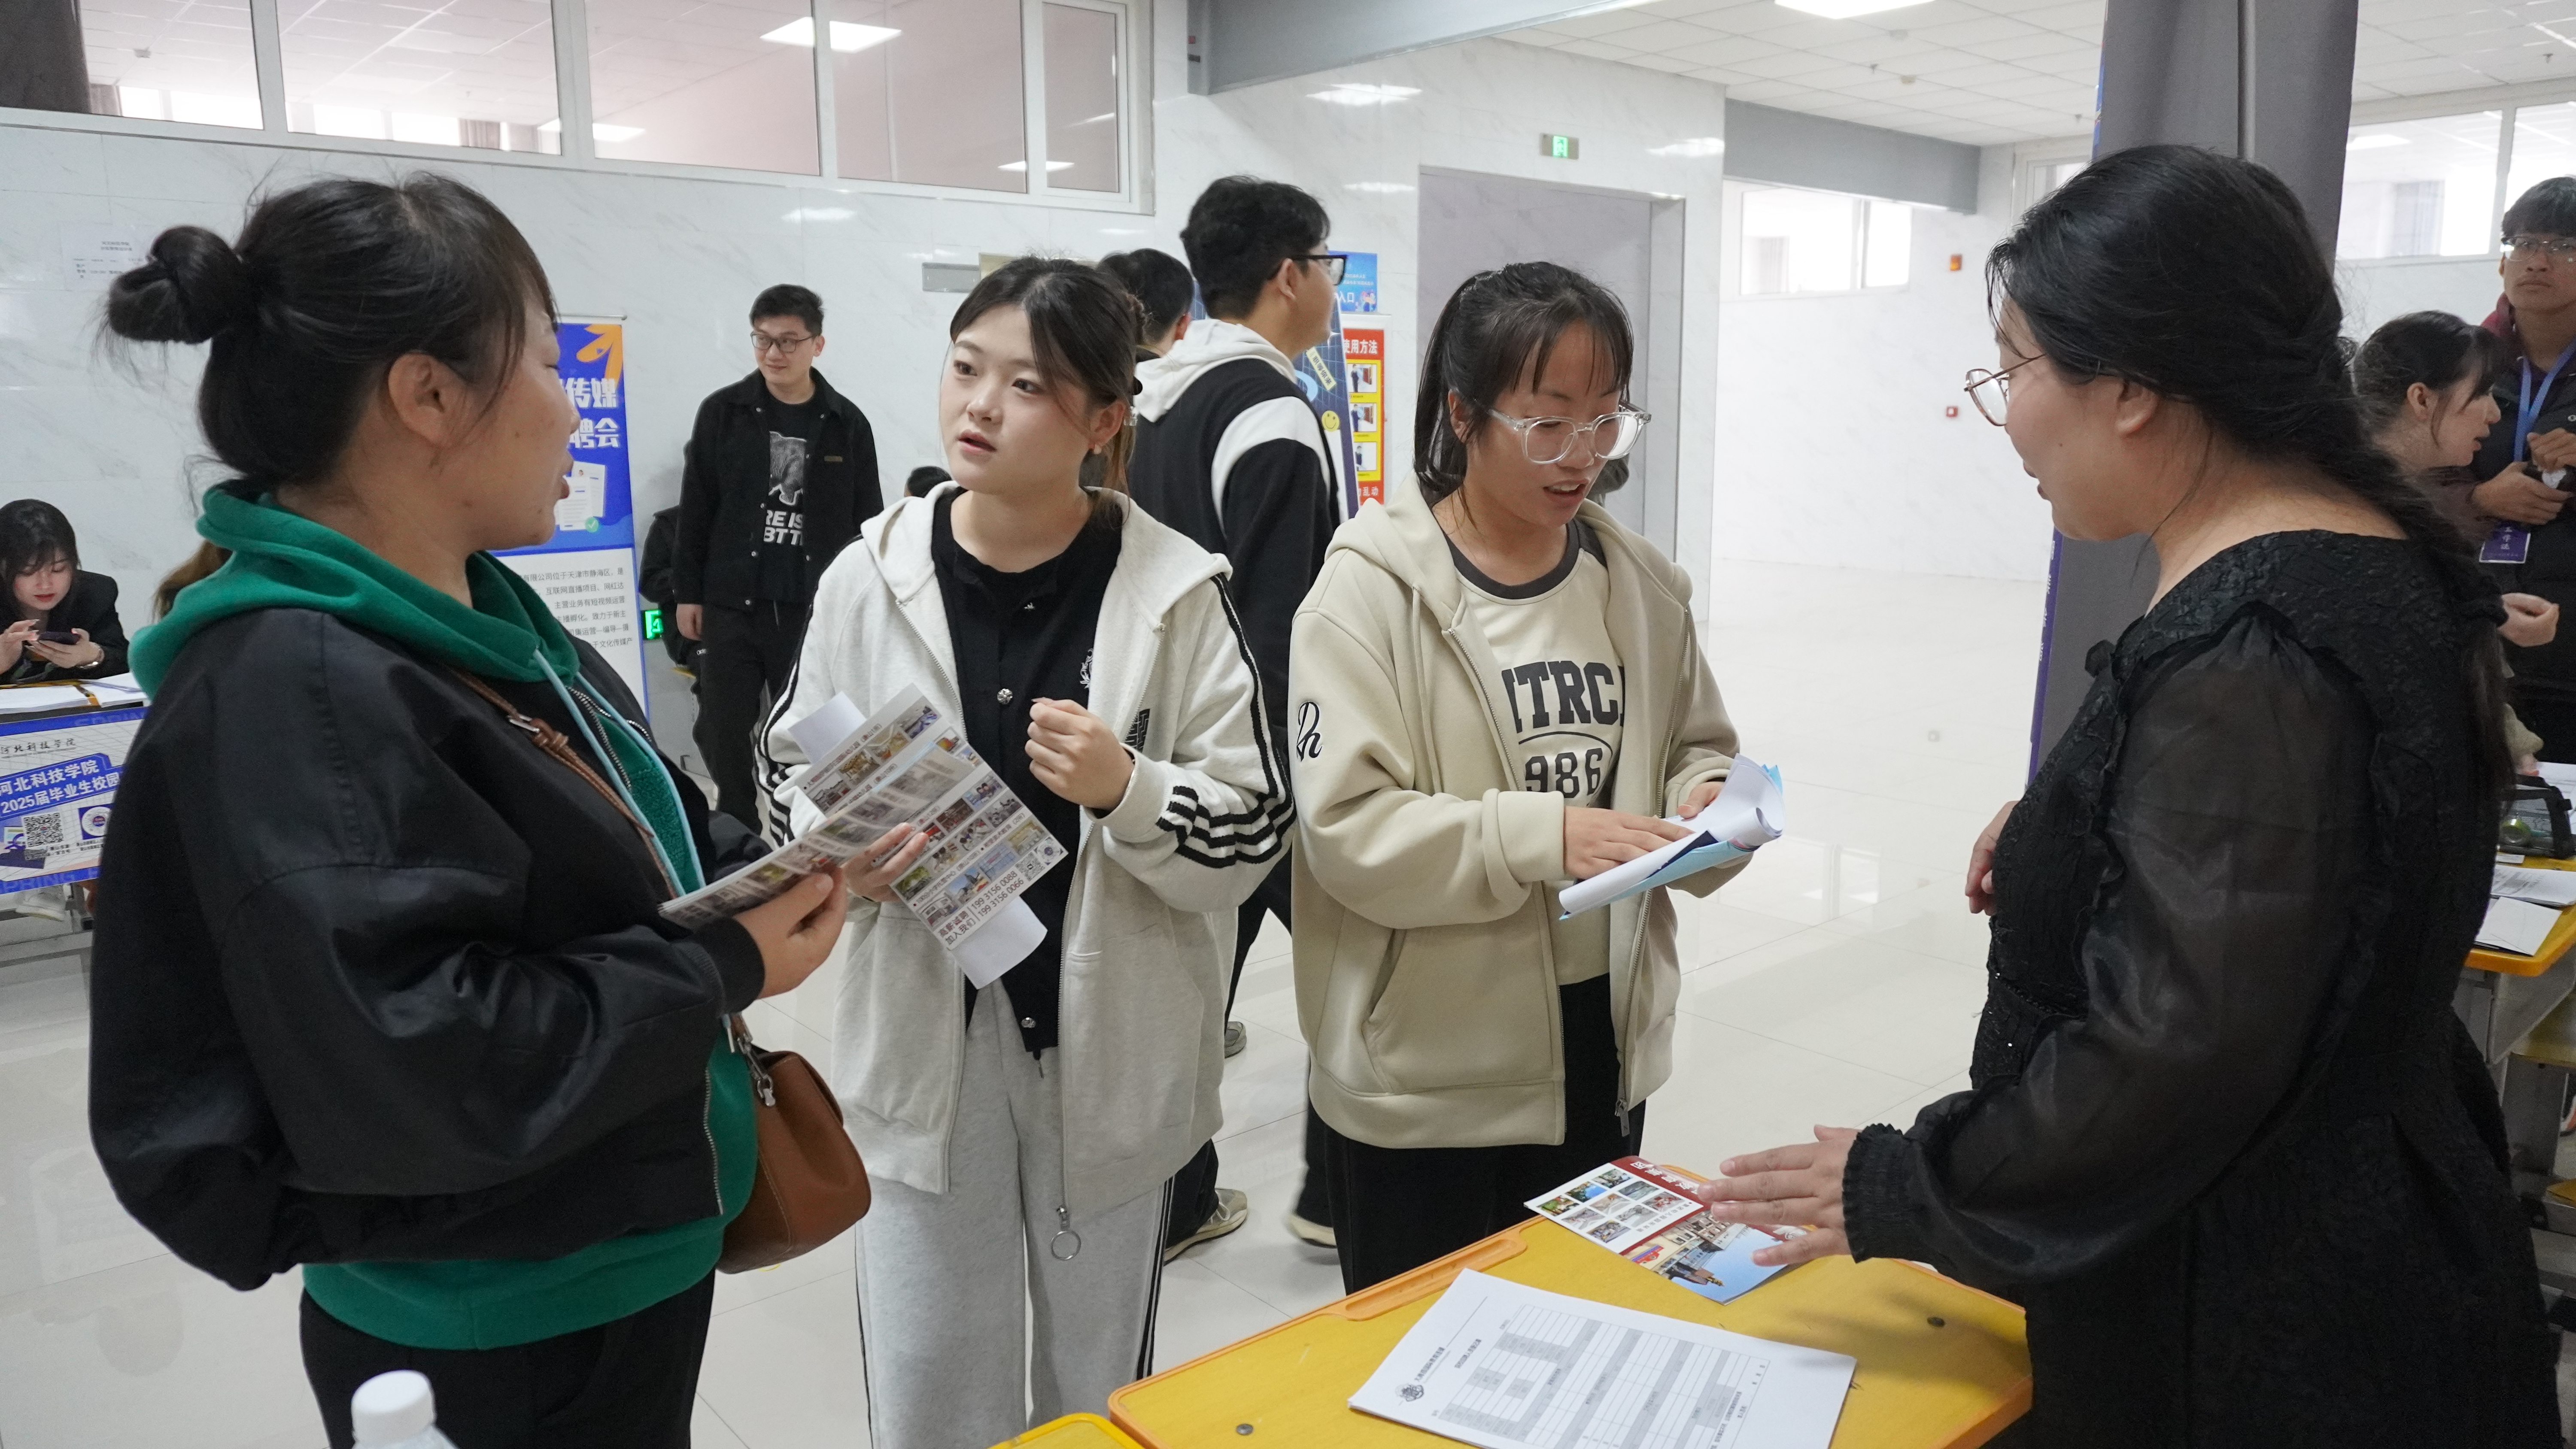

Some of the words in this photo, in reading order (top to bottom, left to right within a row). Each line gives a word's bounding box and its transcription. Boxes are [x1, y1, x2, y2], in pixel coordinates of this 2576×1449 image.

[559, 378, 617, 408] 传媒
[0, 759, 100, 796] 河北科技学院
[1525, 748, 1603, 798] 986
[1, 772, 120, 814] 2025届毕业生校园
[971, 897, 985, 910] 199
[983, 884, 1001, 900] 3156
[978, 905, 991, 918] 199
[990, 891, 1009, 908] 3156
